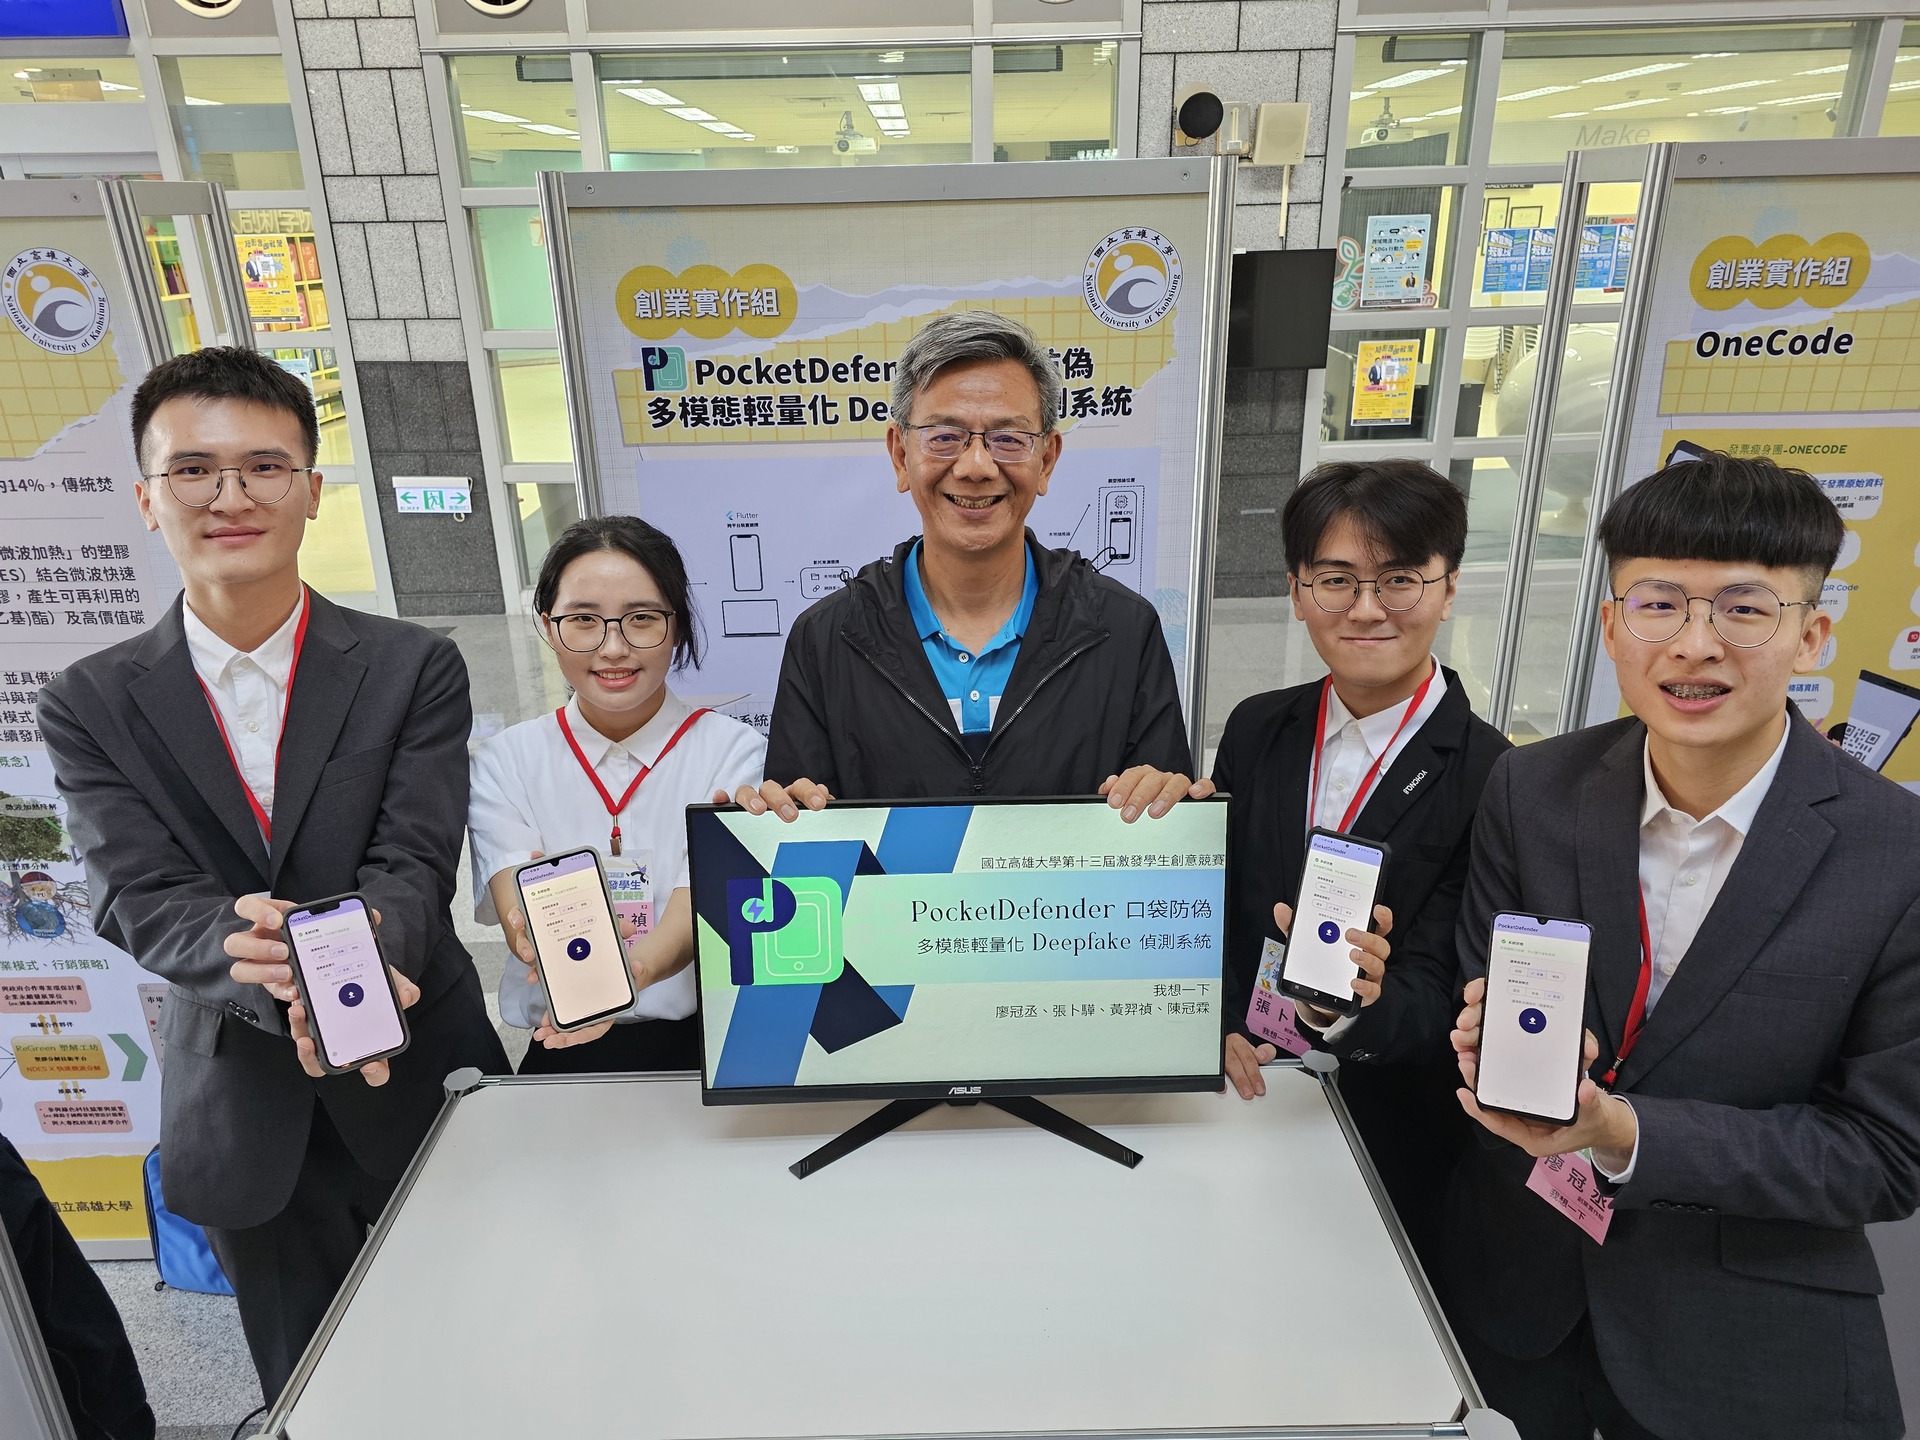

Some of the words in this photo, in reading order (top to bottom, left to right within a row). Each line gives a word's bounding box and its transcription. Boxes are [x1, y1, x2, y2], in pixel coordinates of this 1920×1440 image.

[1575, 124, 1650, 147] Make
[1094, 229, 1174, 258] 國立高雄大學
[6, 250, 90, 278] 國立高雄大學
[1705, 256, 1852, 290] 創業實作組
[633, 287, 780, 319] 創業實作組
[1085, 274, 1100, 312] National
[1100, 311, 1140, 329] University
[1144, 315, 1153, 325] of
[1156, 274, 1181, 318] Kaohsiung
[4, 295, 30, 332] National
[32, 333, 77, 352] University
[81, 339, 90, 348] of
[89, 296, 107, 341] Kaohsiung
[1696, 326, 1854, 358] OneCode
[648, 394, 839, 428] 多模態輕量化
[849, 397, 895, 422] De
[1059, 386, 1132, 418] 系統
[0, 710, 35, 724] 模式
[0, 730, 45, 743] 續發展
[981, 854, 1226, 870] 國立高雄大學第十三屆激發學生創意競賽
[912, 897, 1116, 923] PocketDefender
[1126, 899, 1212, 919] 口袋防偽
[917, 936, 1024, 955] 多模態輕量化
[1032, 931, 1131, 956] Deepfake
[1139, 933, 1211, 951] 偵測系統
[1153, 983, 1210, 997] 我想一下
[15, 1044, 56, 1052] ReGreen
[1262, 1026, 1292, 1047] 我想一下
[948, 1086, 982, 1095] ASUS
[1550, 1188, 1586, 1220] 我想一下
